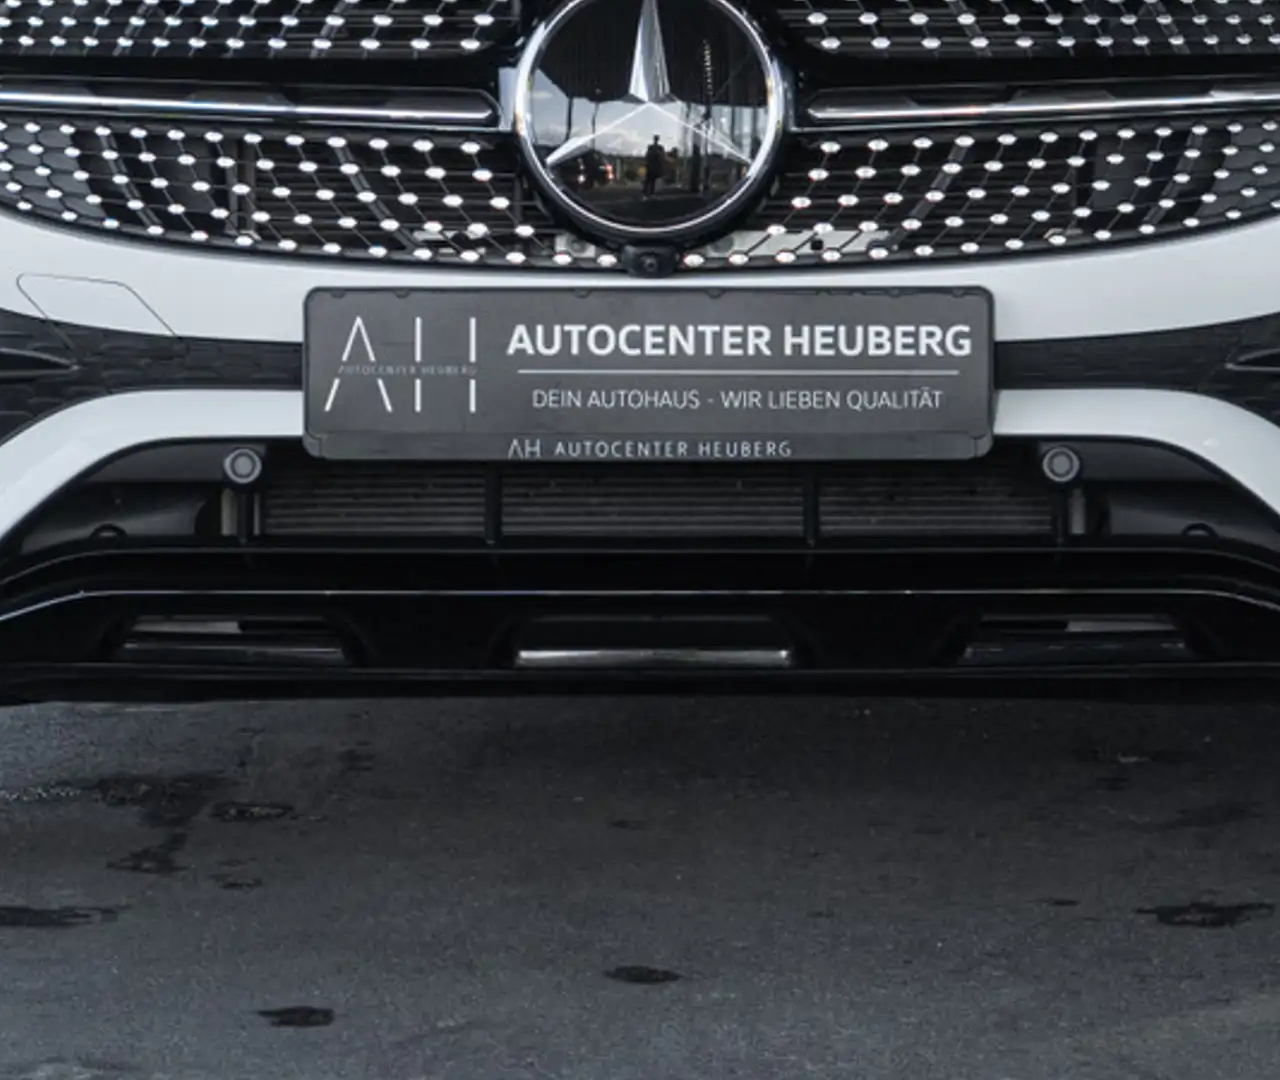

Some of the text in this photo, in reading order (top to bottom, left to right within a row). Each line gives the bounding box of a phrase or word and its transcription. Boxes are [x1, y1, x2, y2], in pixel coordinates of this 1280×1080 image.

[506, 324, 972, 357] AUTOCENTER HEUBERG
[324, 316, 476, 413] AH
[531, 389, 582, 409] DEIN
[586, 389, 701, 409] AUTOHAUS
[720, 390, 763, 410] WIR
[768, 390, 841, 410] LIEBEN
[846, 387, 943, 412] QUALITÄT
[507, 438, 792, 460] AH AUTOCENTER HEUBERG
